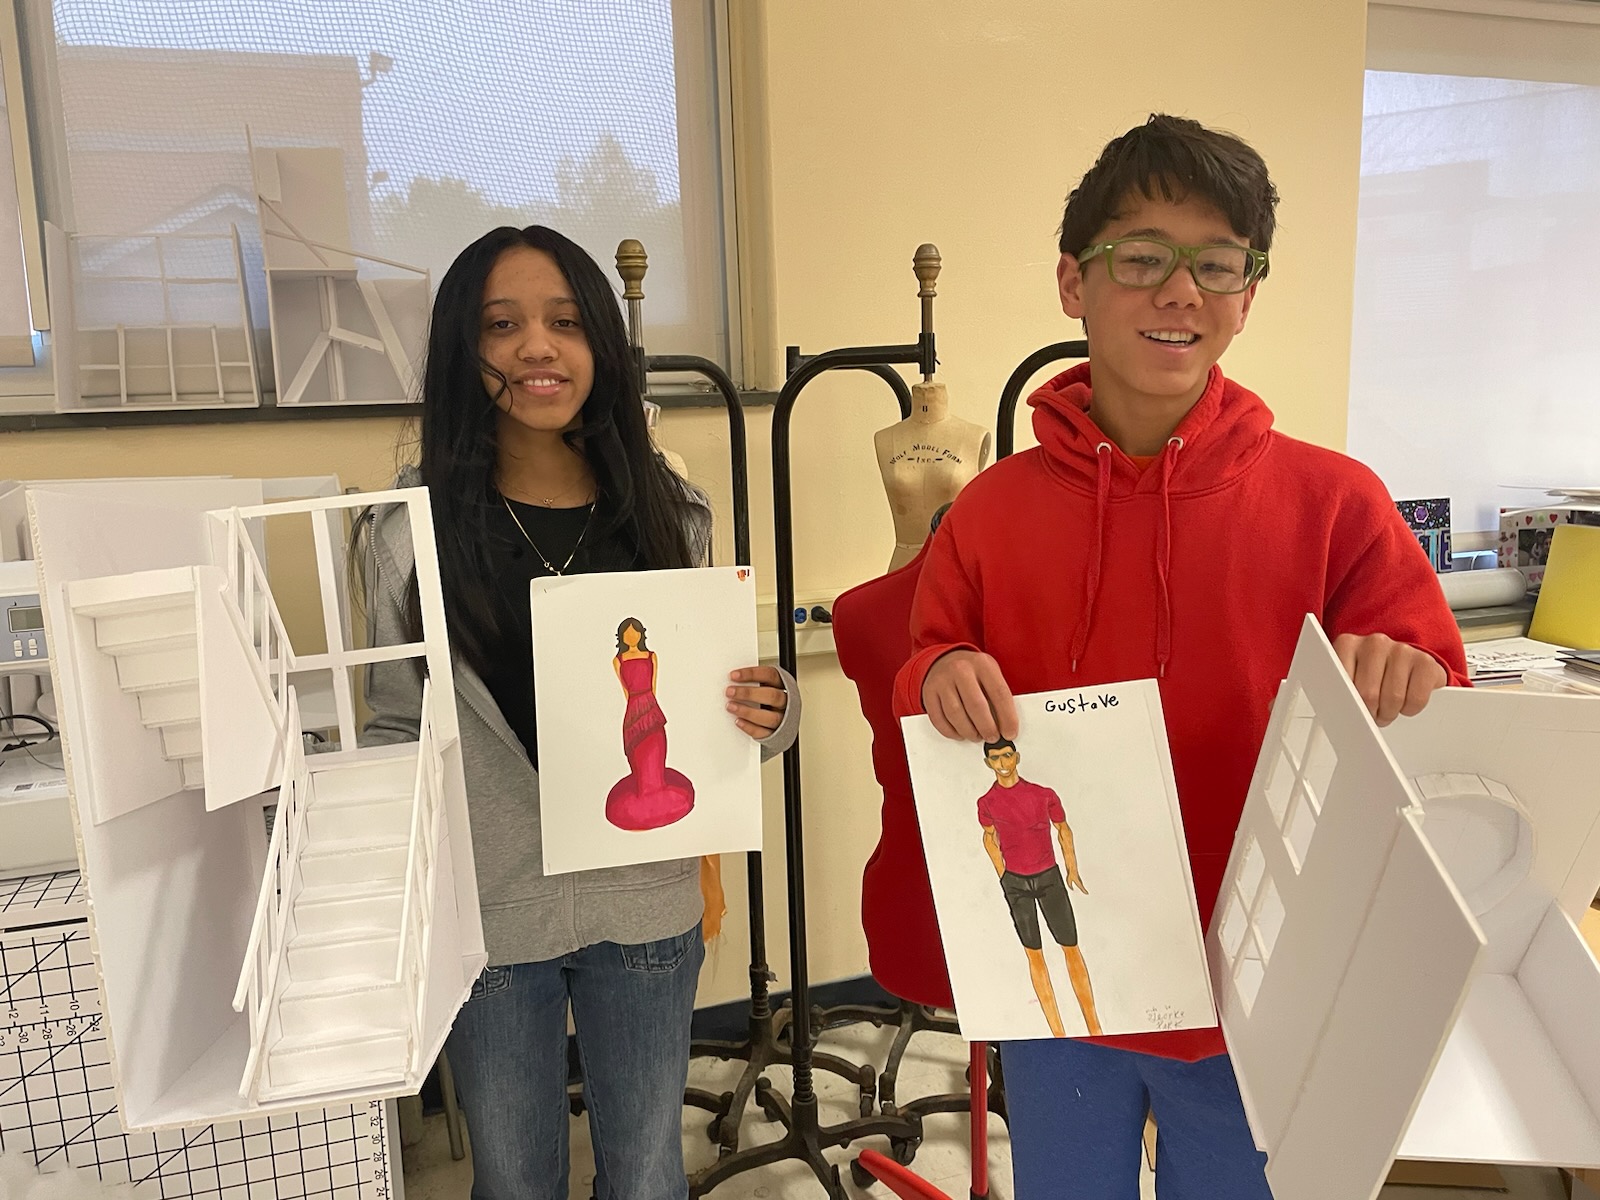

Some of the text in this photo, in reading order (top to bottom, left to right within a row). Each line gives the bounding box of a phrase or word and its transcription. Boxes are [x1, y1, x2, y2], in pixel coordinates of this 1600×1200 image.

[39, 1004, 49, 1015] 11
[69, 1000, 80, 1011] 10
[8, 1008, 19, 1019] 12
[42, 1028, 53, 1040] 28
[66, 1024, 77, 1036] 26
[18, 1031, 29, 1043] 30
[370, 1116, 379, 1127] 32
[372, 1134, 380, 1145] 30
[373, 1151, 382, 1162] 28
[375, 1169, 384, 1180] 26
[377, 1187, 385, 1197] 24
